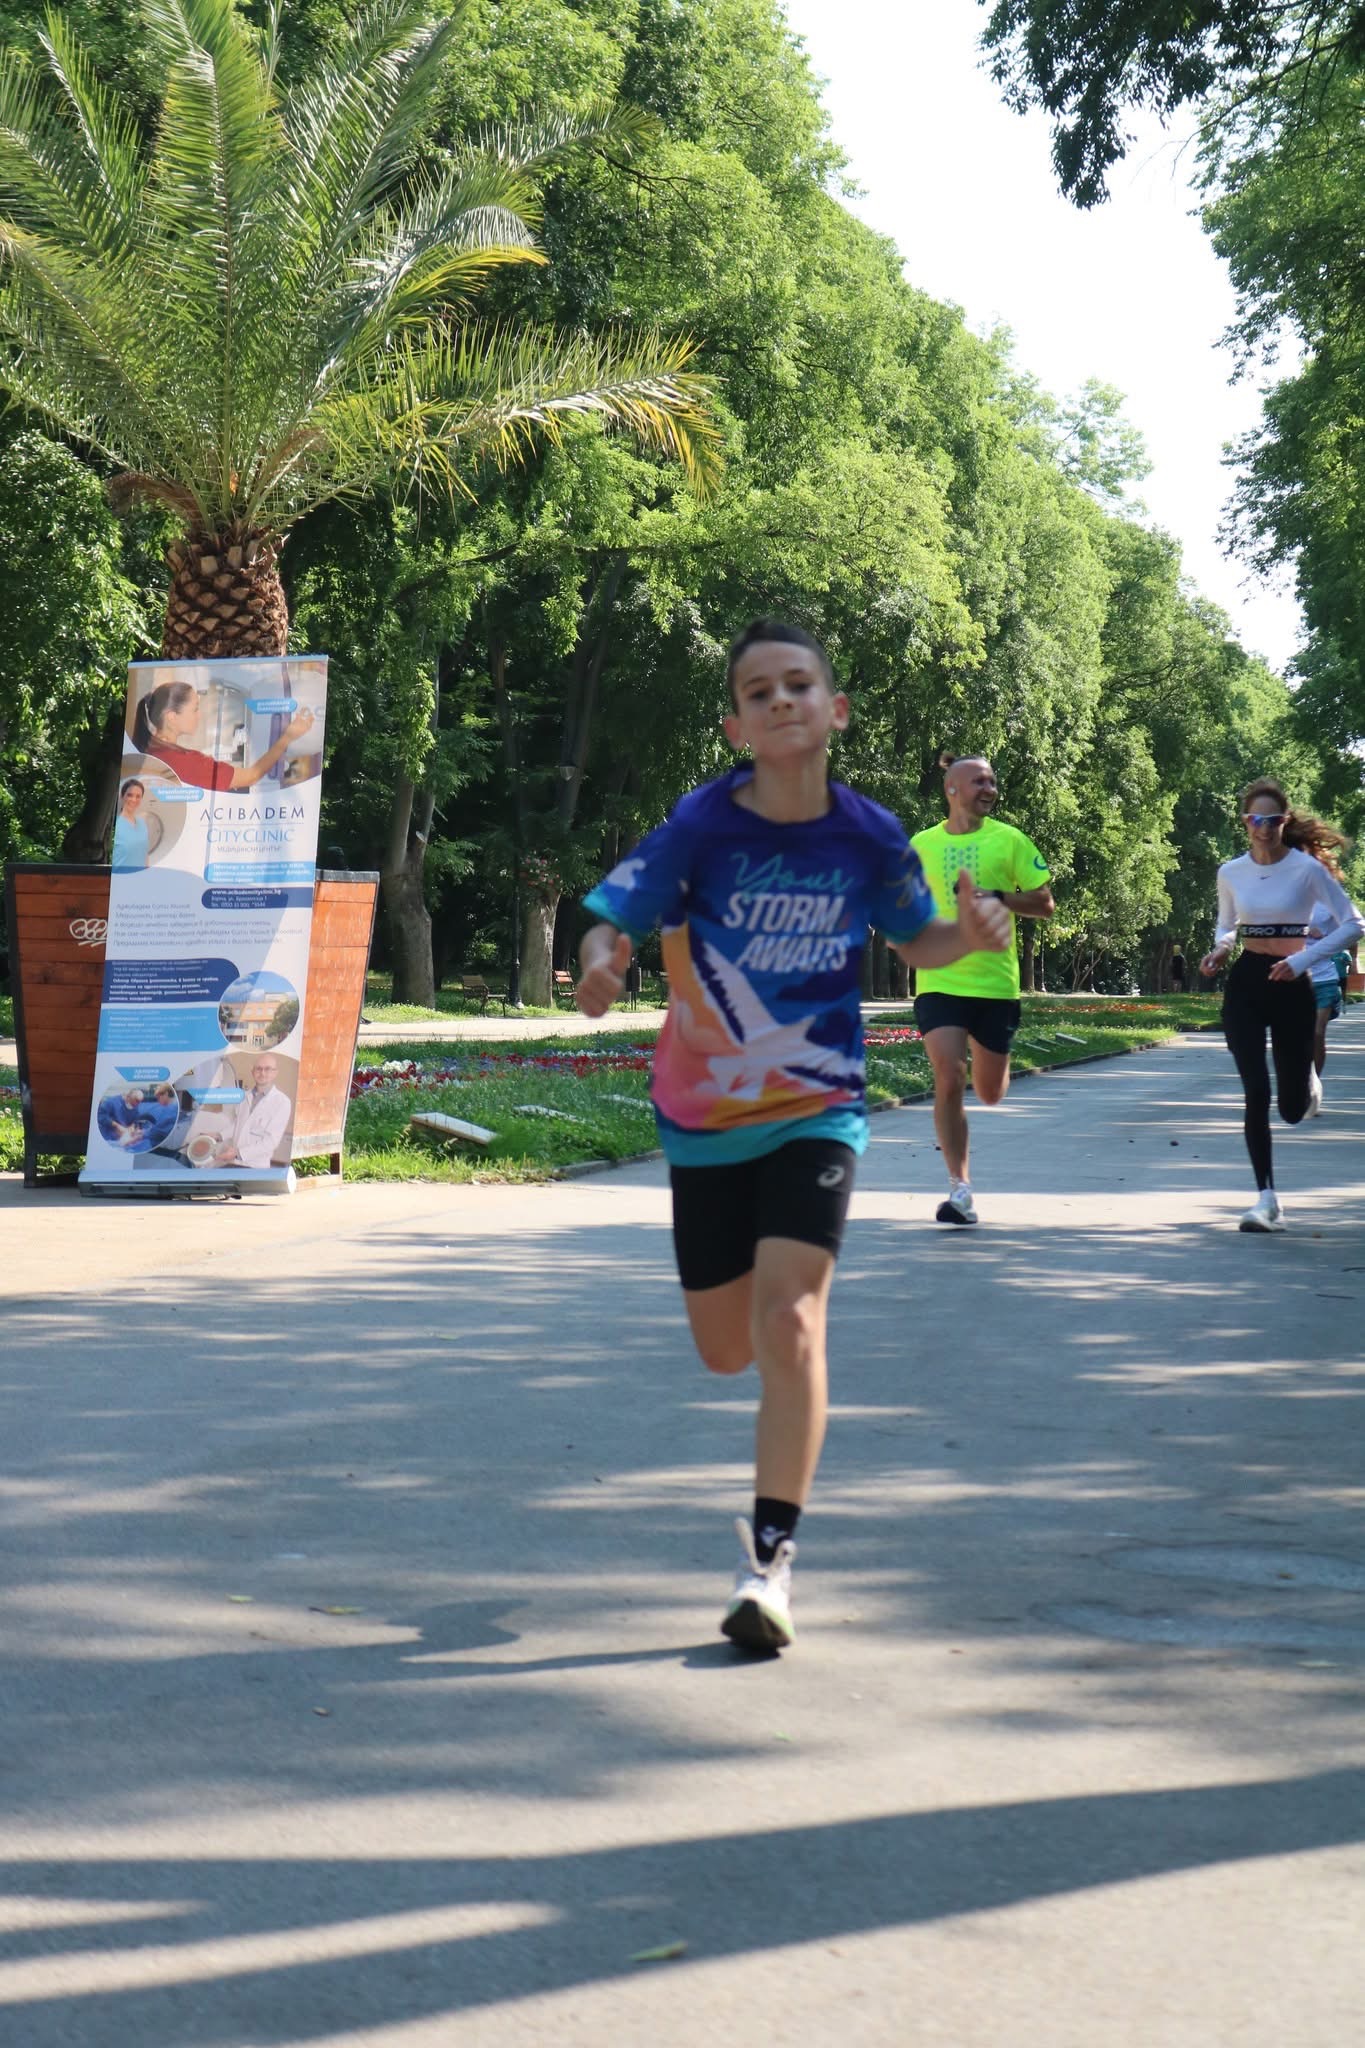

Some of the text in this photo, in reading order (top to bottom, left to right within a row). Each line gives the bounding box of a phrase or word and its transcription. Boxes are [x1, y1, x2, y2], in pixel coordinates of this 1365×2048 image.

[199, 806, 305, 821] ACIBADEM
[242, 828, 296, 843] CLINIC
[730, 852, 855, 902] Your
[722, 892, 846, 934] STORM
[1282, 926, 1310, 935] NIKE
[735, 933, 852, 973] AWAITS
